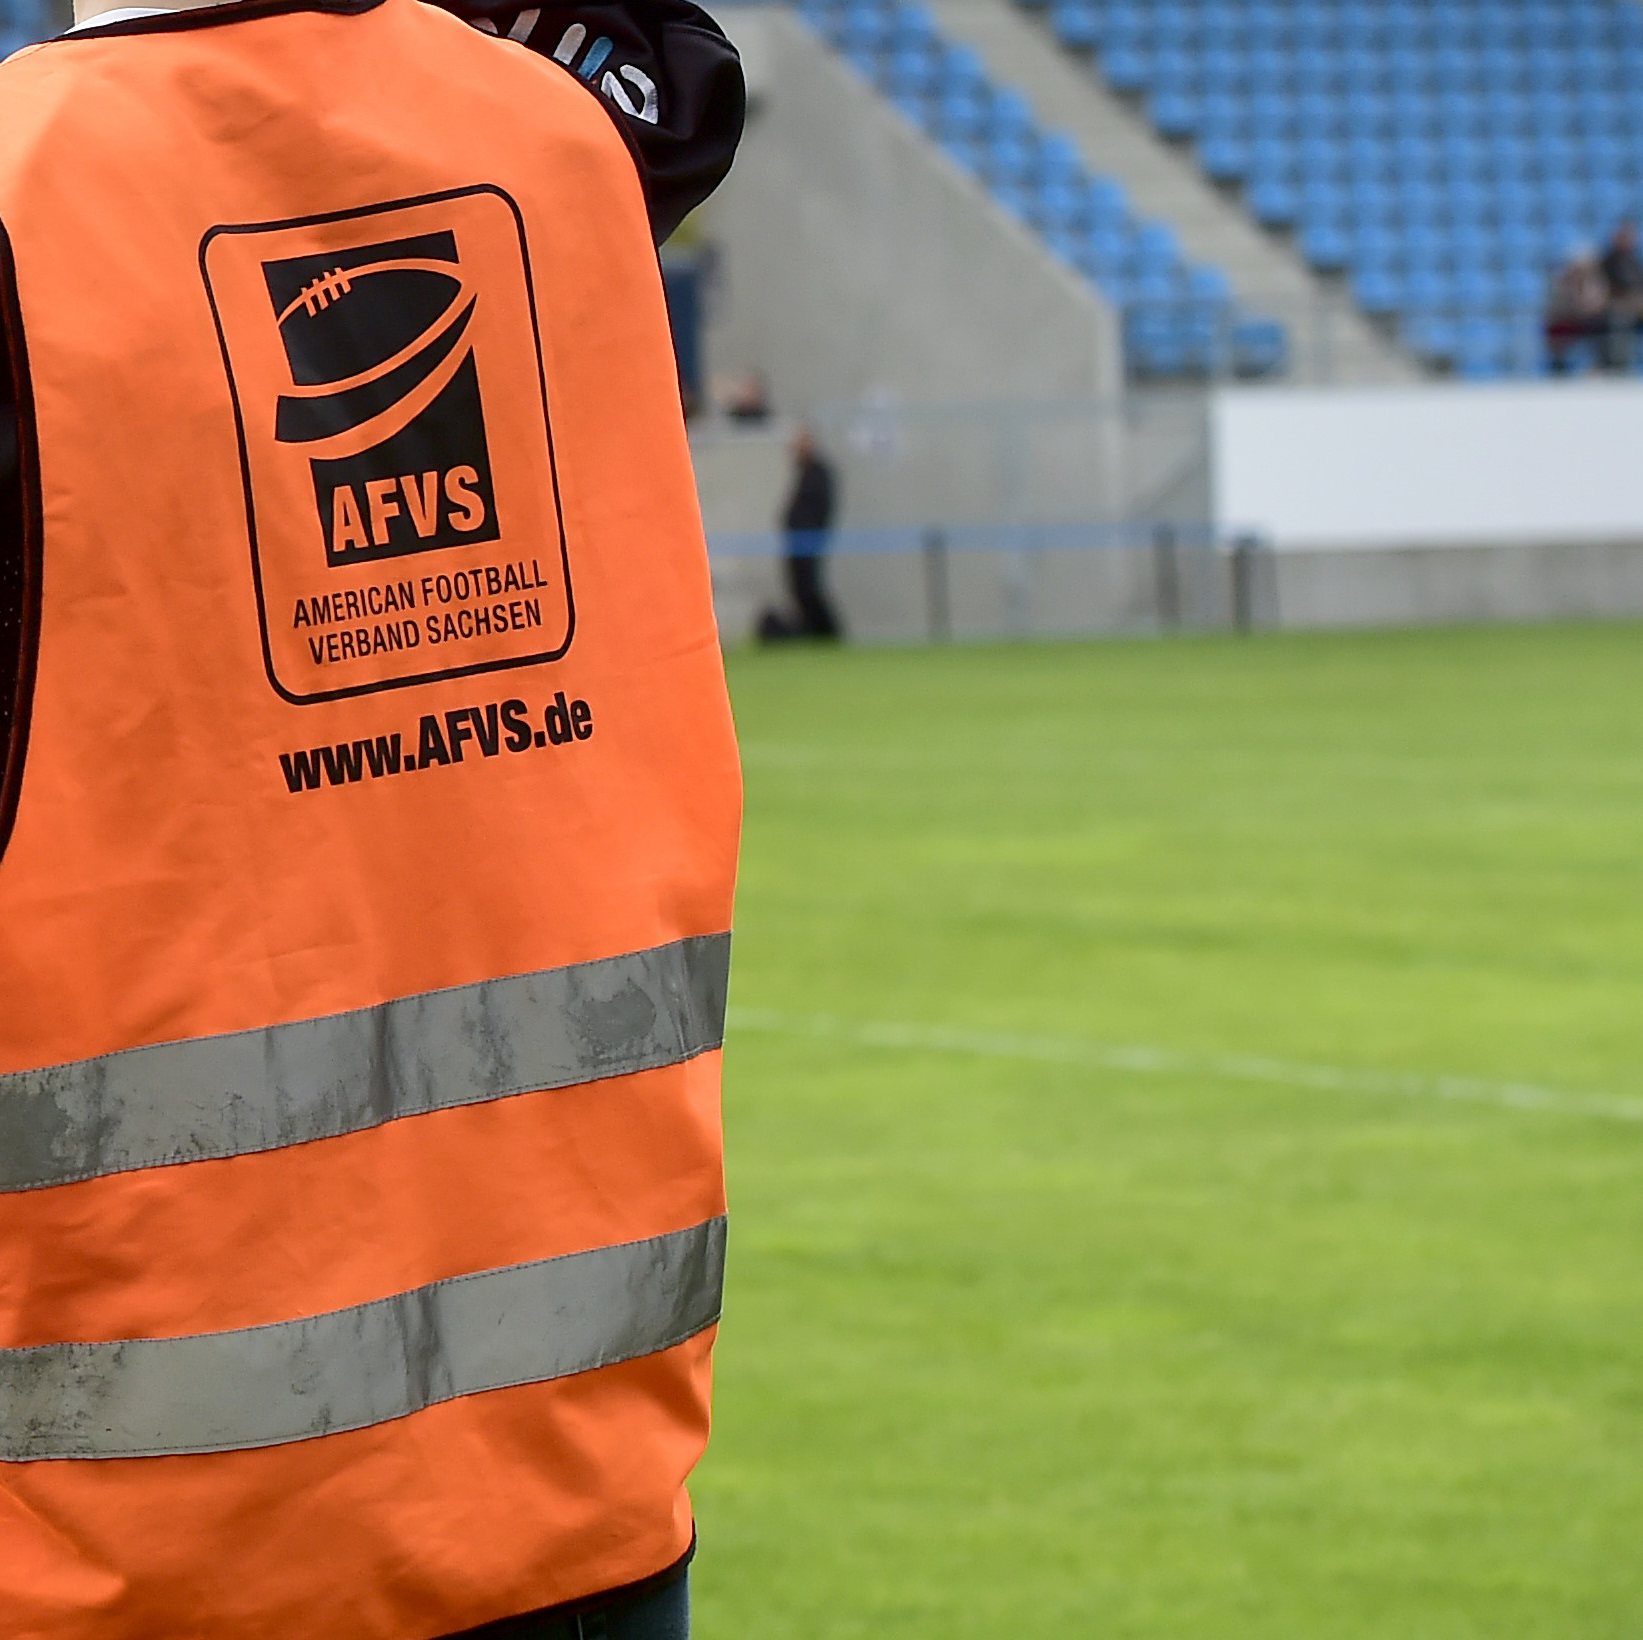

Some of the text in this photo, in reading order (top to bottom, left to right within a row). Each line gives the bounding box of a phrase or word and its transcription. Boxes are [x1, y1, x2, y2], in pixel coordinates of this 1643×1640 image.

[331, 464, 486, 553] AFVS
[293, 559, 548, 629] AMERICAN FOOTBALL
[309, 599, 543, 665] VERBAND SACHSEN
[279, 691, 594, 794] www.AFVS.de
